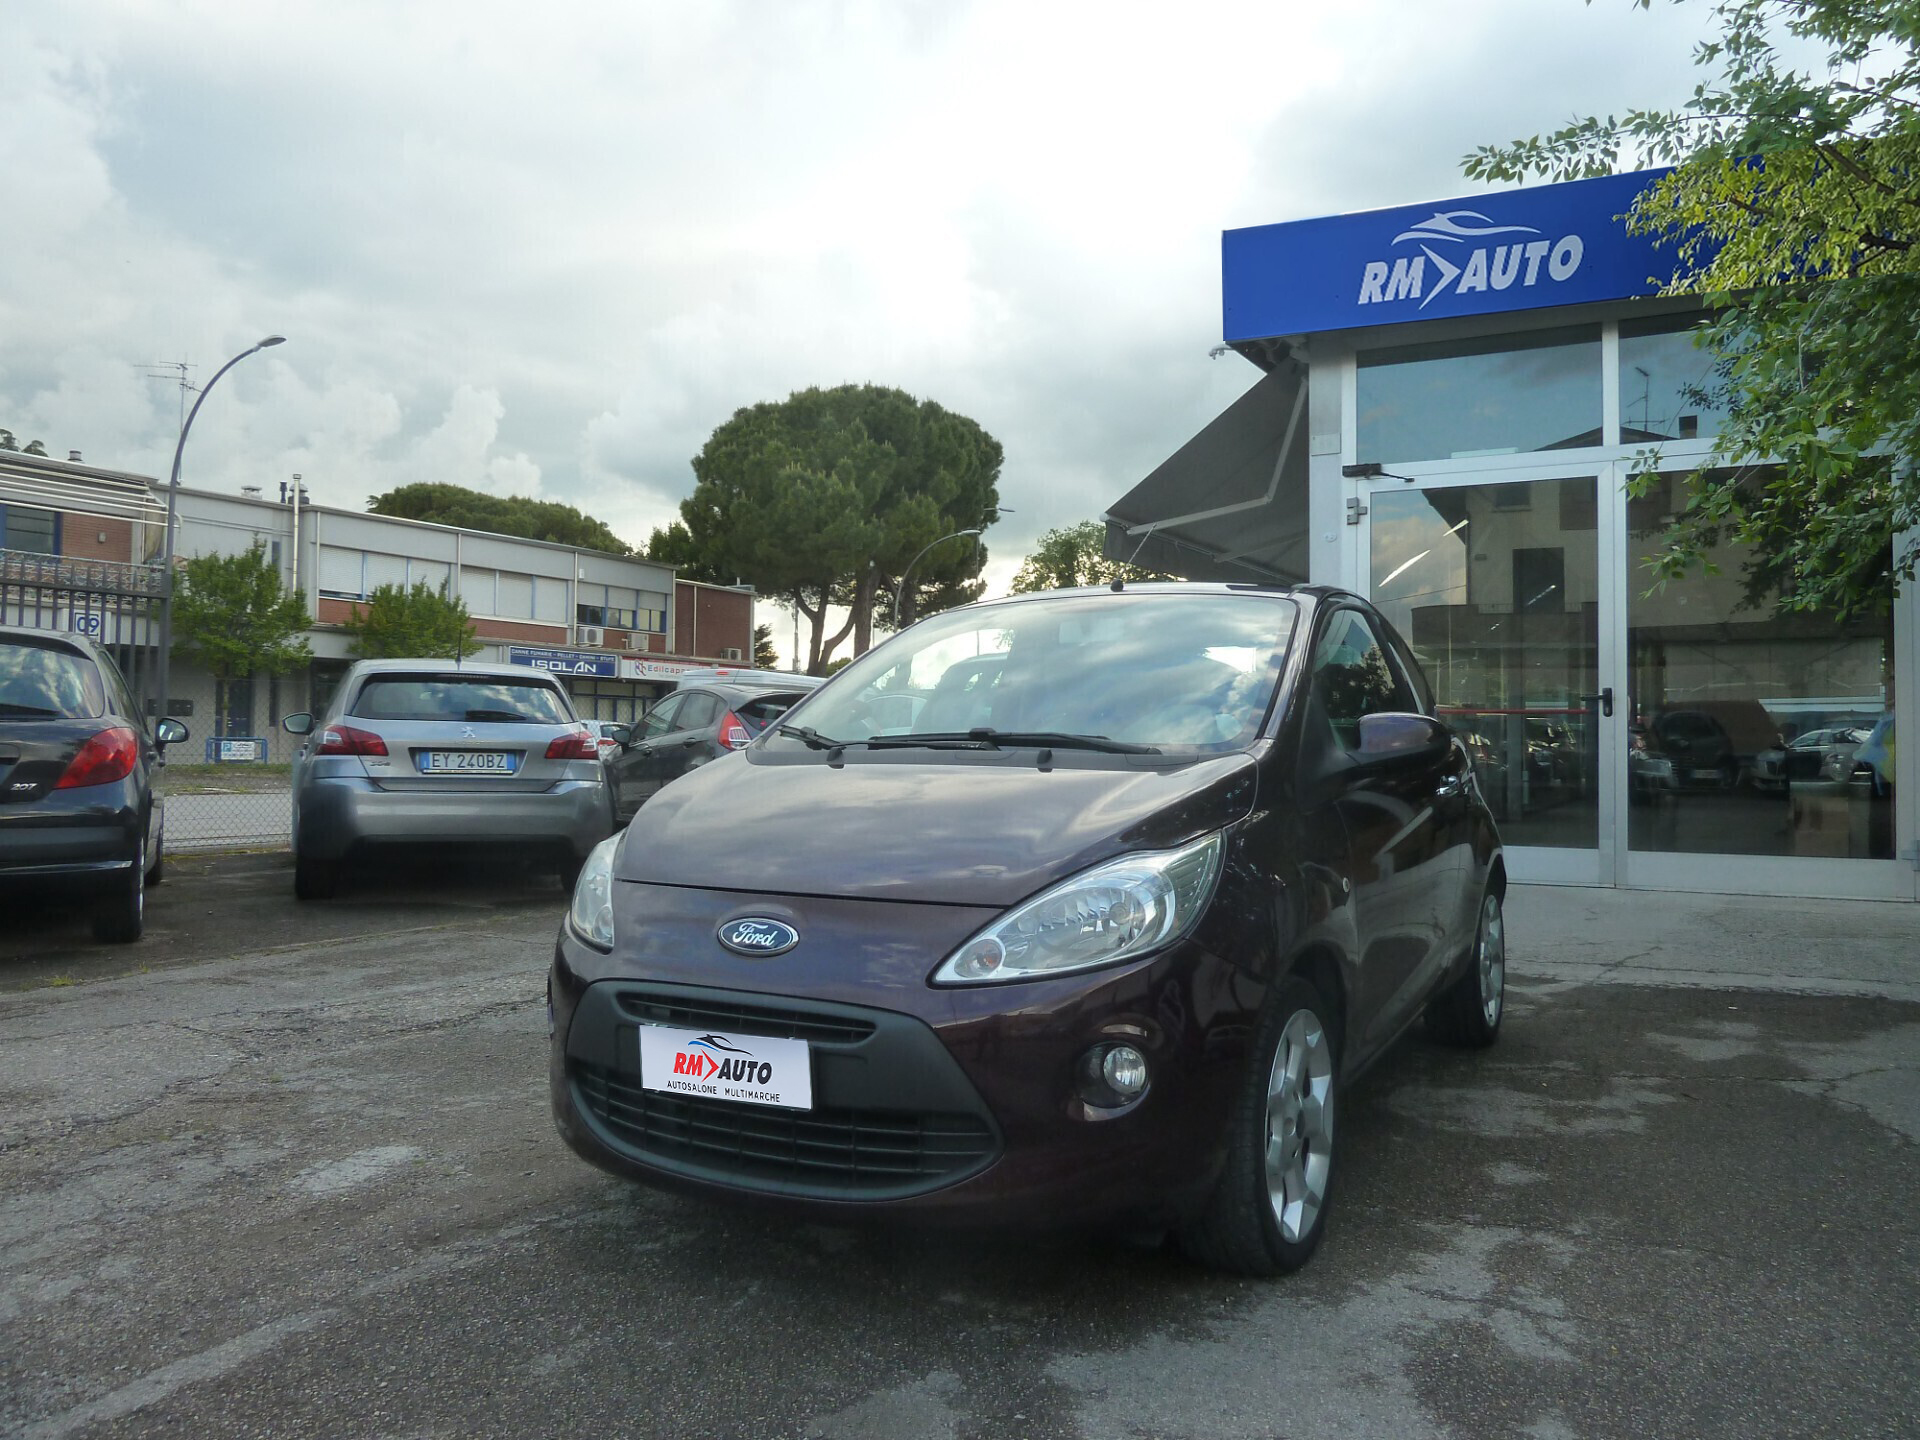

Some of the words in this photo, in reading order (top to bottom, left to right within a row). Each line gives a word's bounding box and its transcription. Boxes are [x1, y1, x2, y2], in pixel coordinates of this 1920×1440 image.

[1358, 256, 1425, 305] RM
[1455, 235, 1584, 294] AUTO
[77, 616, 99, 633] 09
[531, 659, 596, 674] ISOLAN
[432, 753, 450, 767] EY
[457, 754, 505, 768] 240BZ
[732, 922, 778, 945] Ford
[674, 1052, 704, 1076] RM
[717, 1058, 772, 1084] AUTO
[667, 1080, 717, 1094] AUTOSALONE
[725, 1087, 780, 1102] MULTIMARCHE
